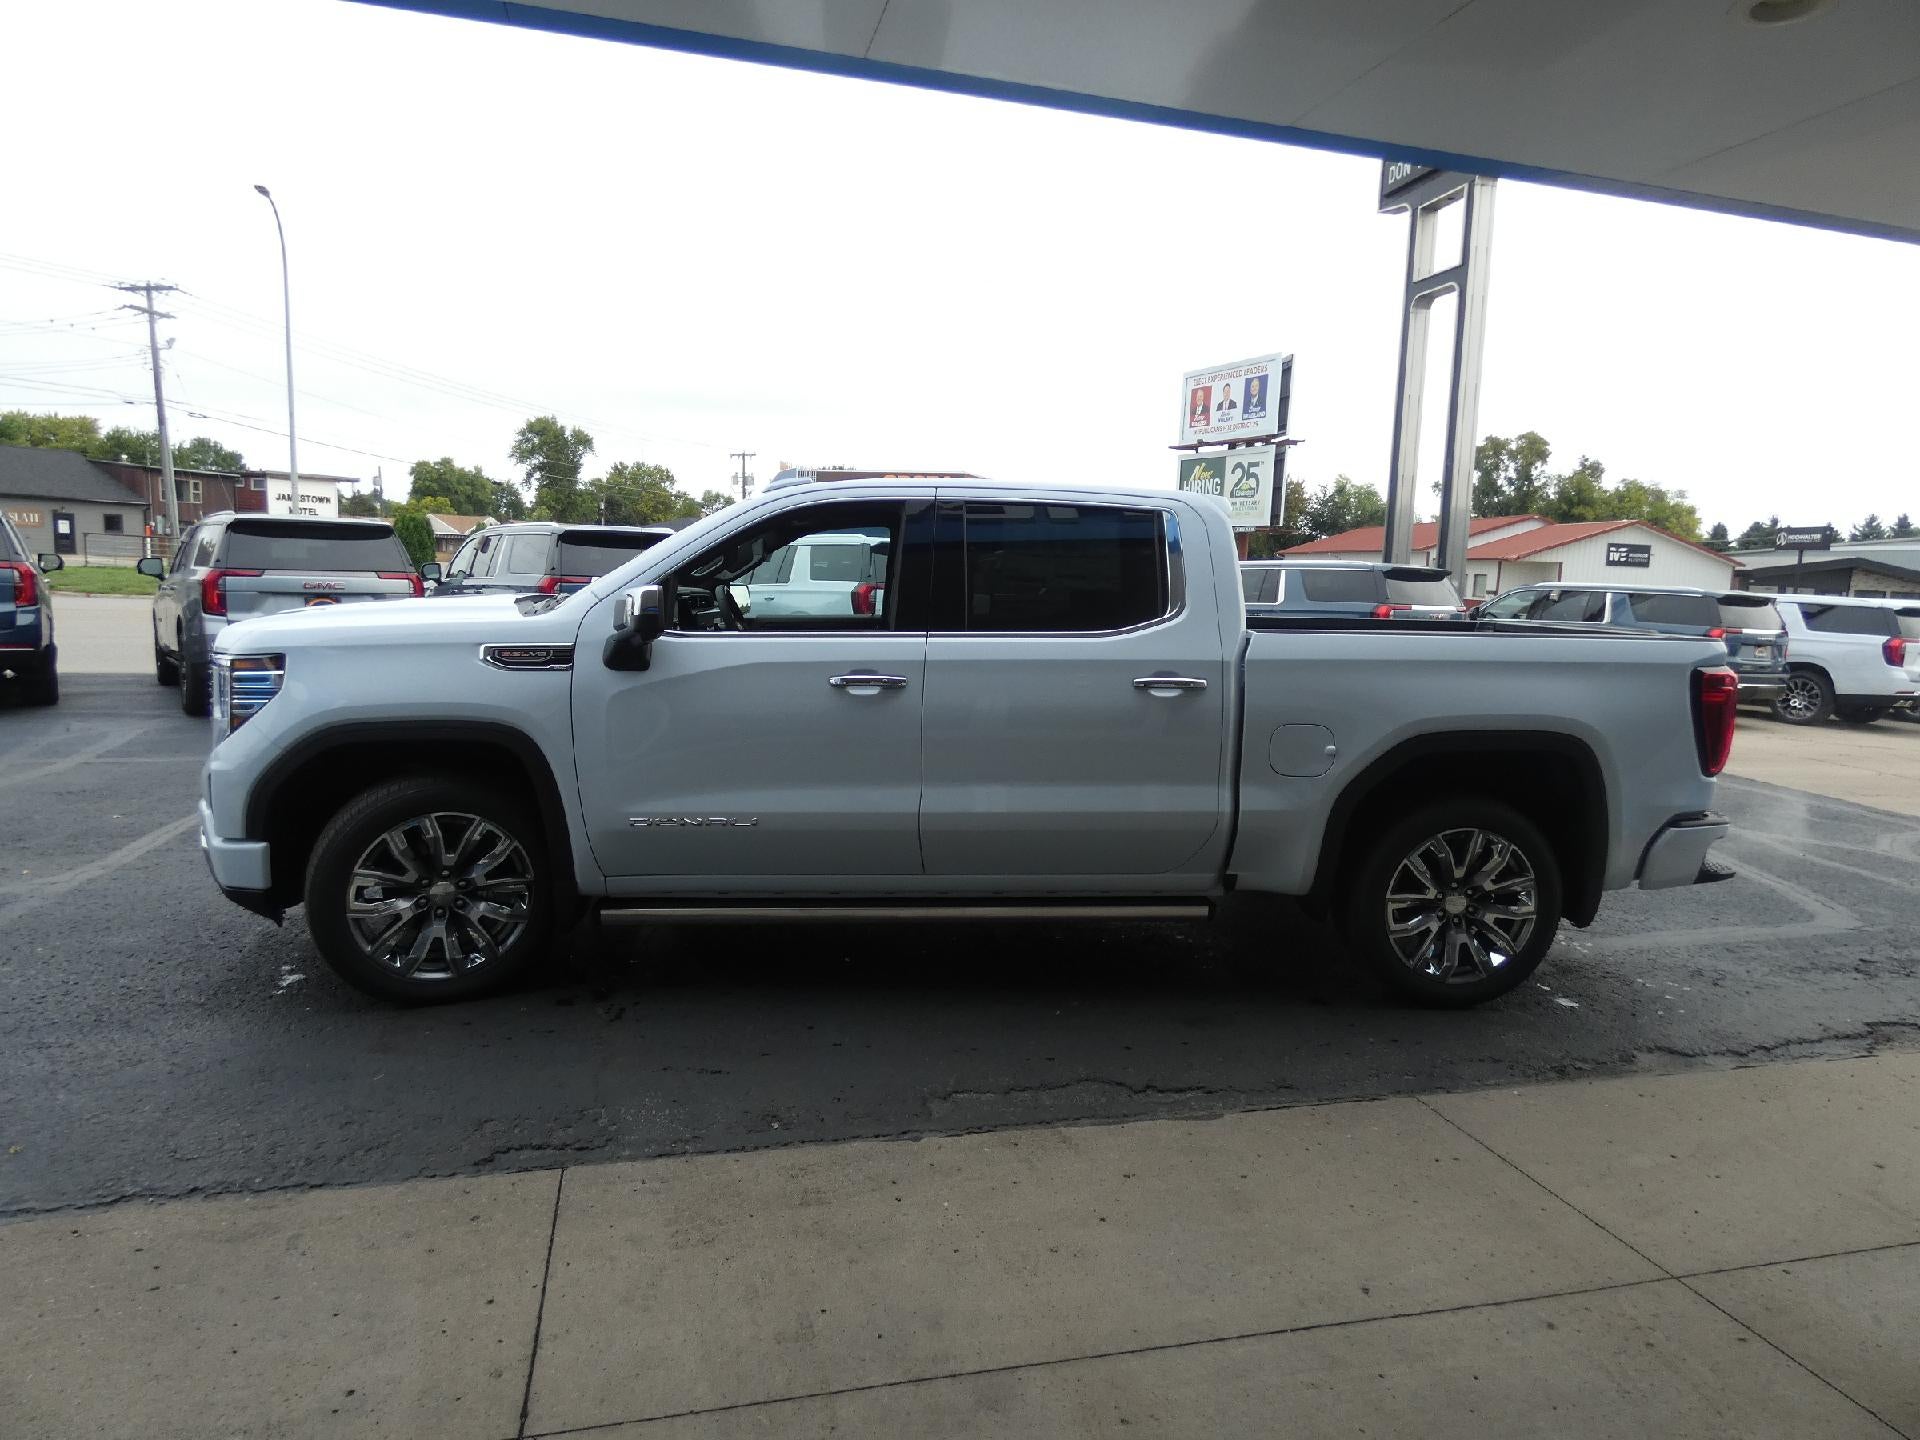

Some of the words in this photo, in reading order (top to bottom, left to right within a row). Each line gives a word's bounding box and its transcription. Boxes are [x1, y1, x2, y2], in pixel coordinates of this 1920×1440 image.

[1389, 162, 1411, 184] DON
[1190, 462, 1214, 480] Now
[1183, 478, 1221, 494] HIRING
[275, 493, 331, 504] JAMSTOWN
[304, 581, 345, 590] GMC
